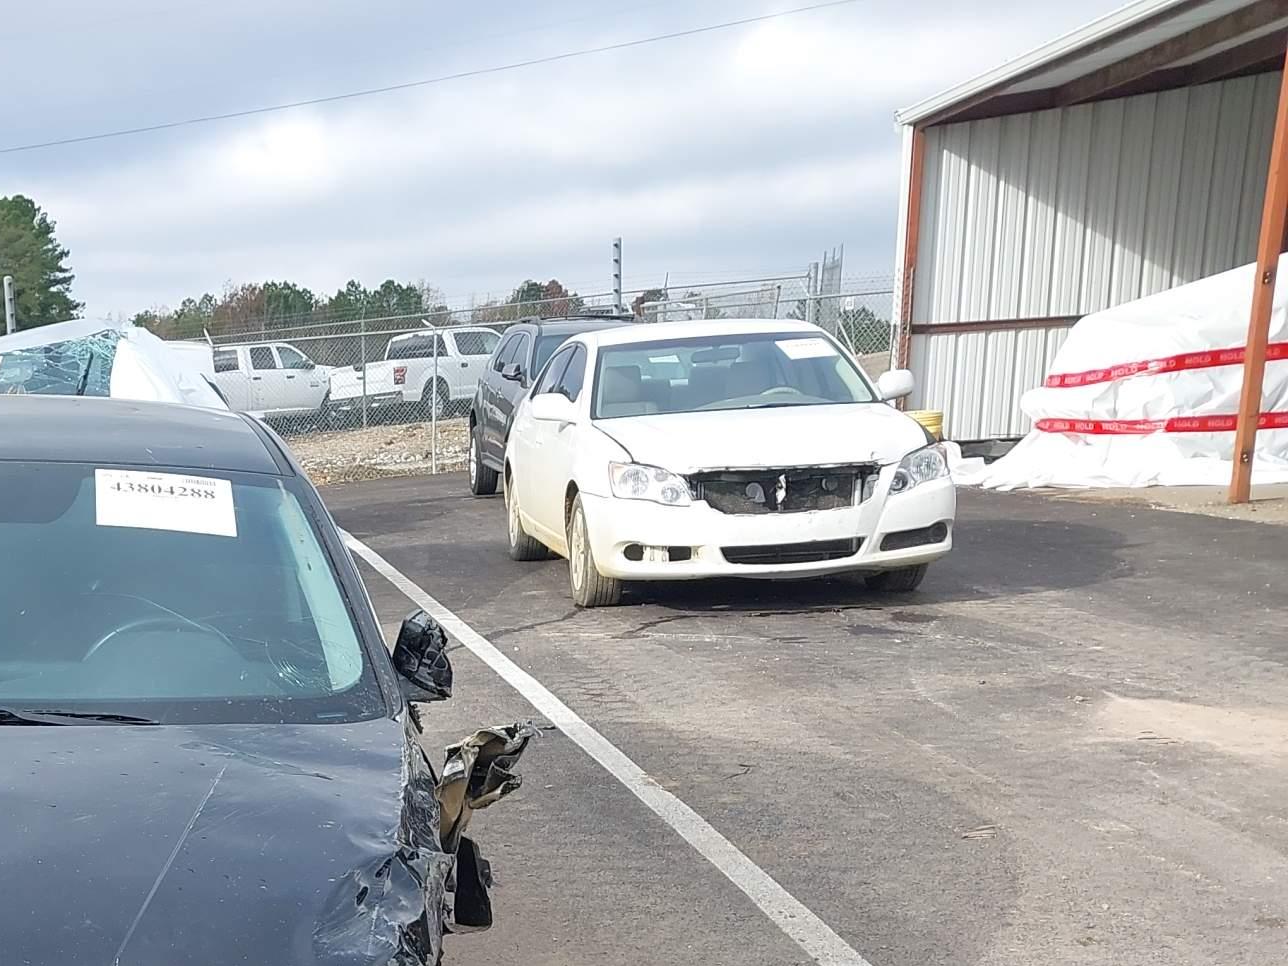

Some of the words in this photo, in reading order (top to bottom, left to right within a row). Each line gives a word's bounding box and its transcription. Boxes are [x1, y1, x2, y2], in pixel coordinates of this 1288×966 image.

[1112, 365, 1138, 377] HOLD
[1075, 422, 1095, 431] HOLD
[1208, 418, 1233, 427] HOLD
[110, 482, 216, 499] 43804288
